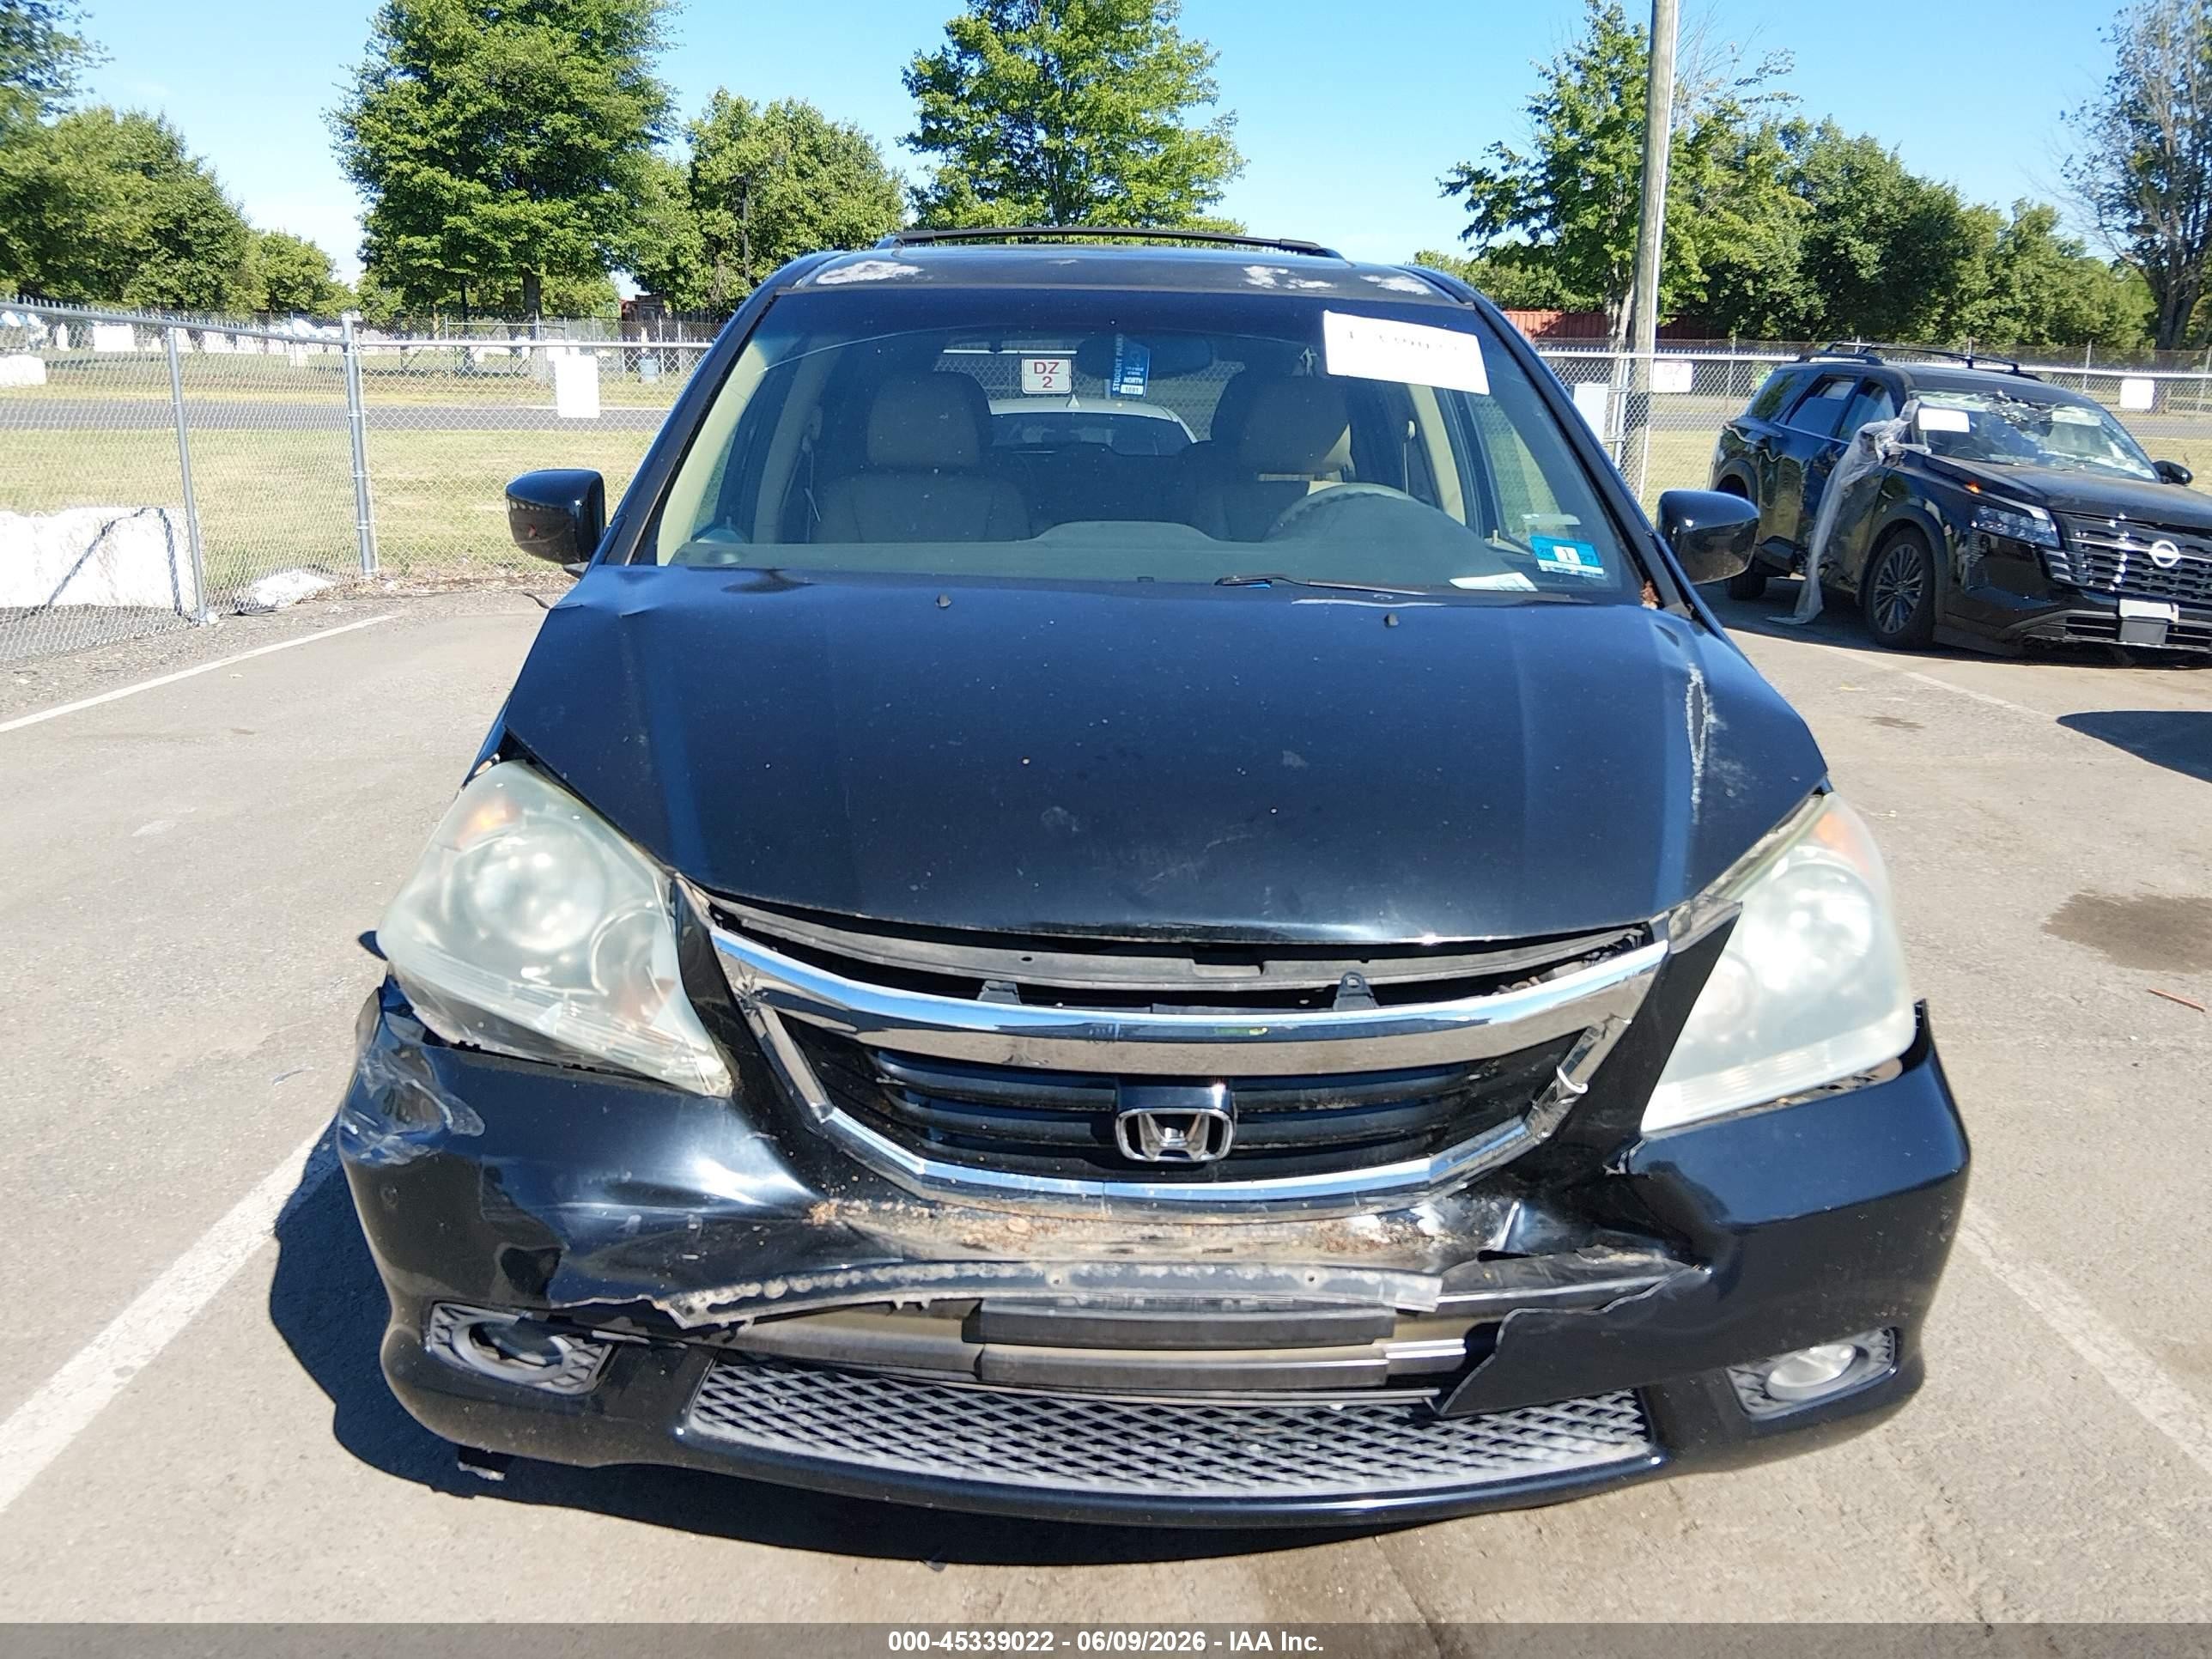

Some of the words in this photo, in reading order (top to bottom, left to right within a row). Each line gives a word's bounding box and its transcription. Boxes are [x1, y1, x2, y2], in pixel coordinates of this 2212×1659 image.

[1034, 362, 1060, 374] DZ
[1042, 375, 1053, 388] 2
[1123, 376, 1144, 385] NORTH
[1562, 549, 1572, 562] 1
